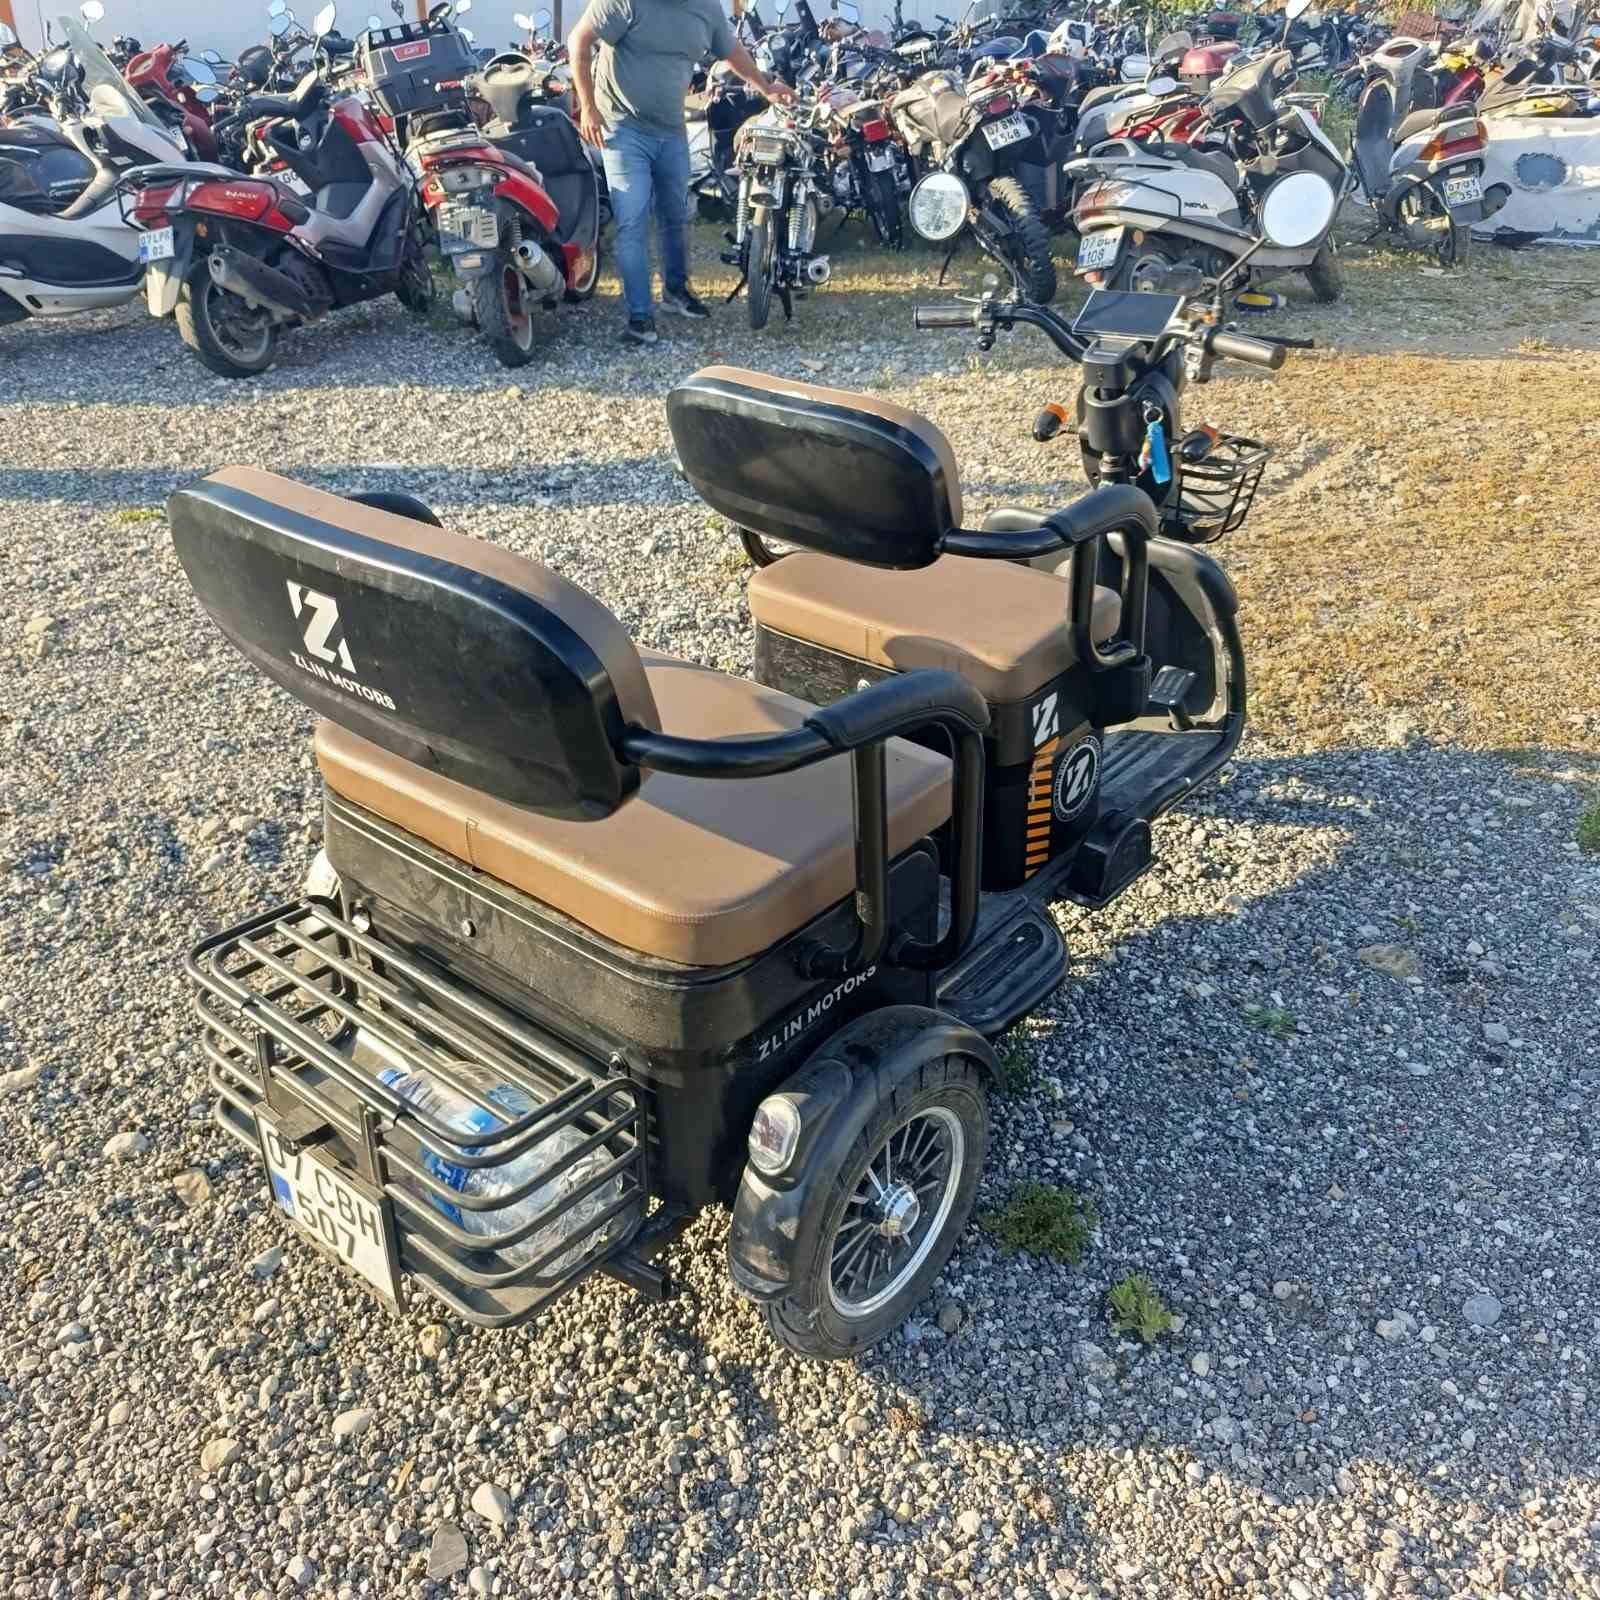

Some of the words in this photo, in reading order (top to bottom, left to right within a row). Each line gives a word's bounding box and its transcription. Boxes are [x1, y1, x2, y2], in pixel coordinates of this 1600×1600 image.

[289, 648, 329, 681] ZLIN
[328, 670, 397, 711] MOTORS
[758, 1015, 802, 1062] ZLIN
[297, 1191, 356, 1258] 507
[315, 1168, 380, 1247] CBH
